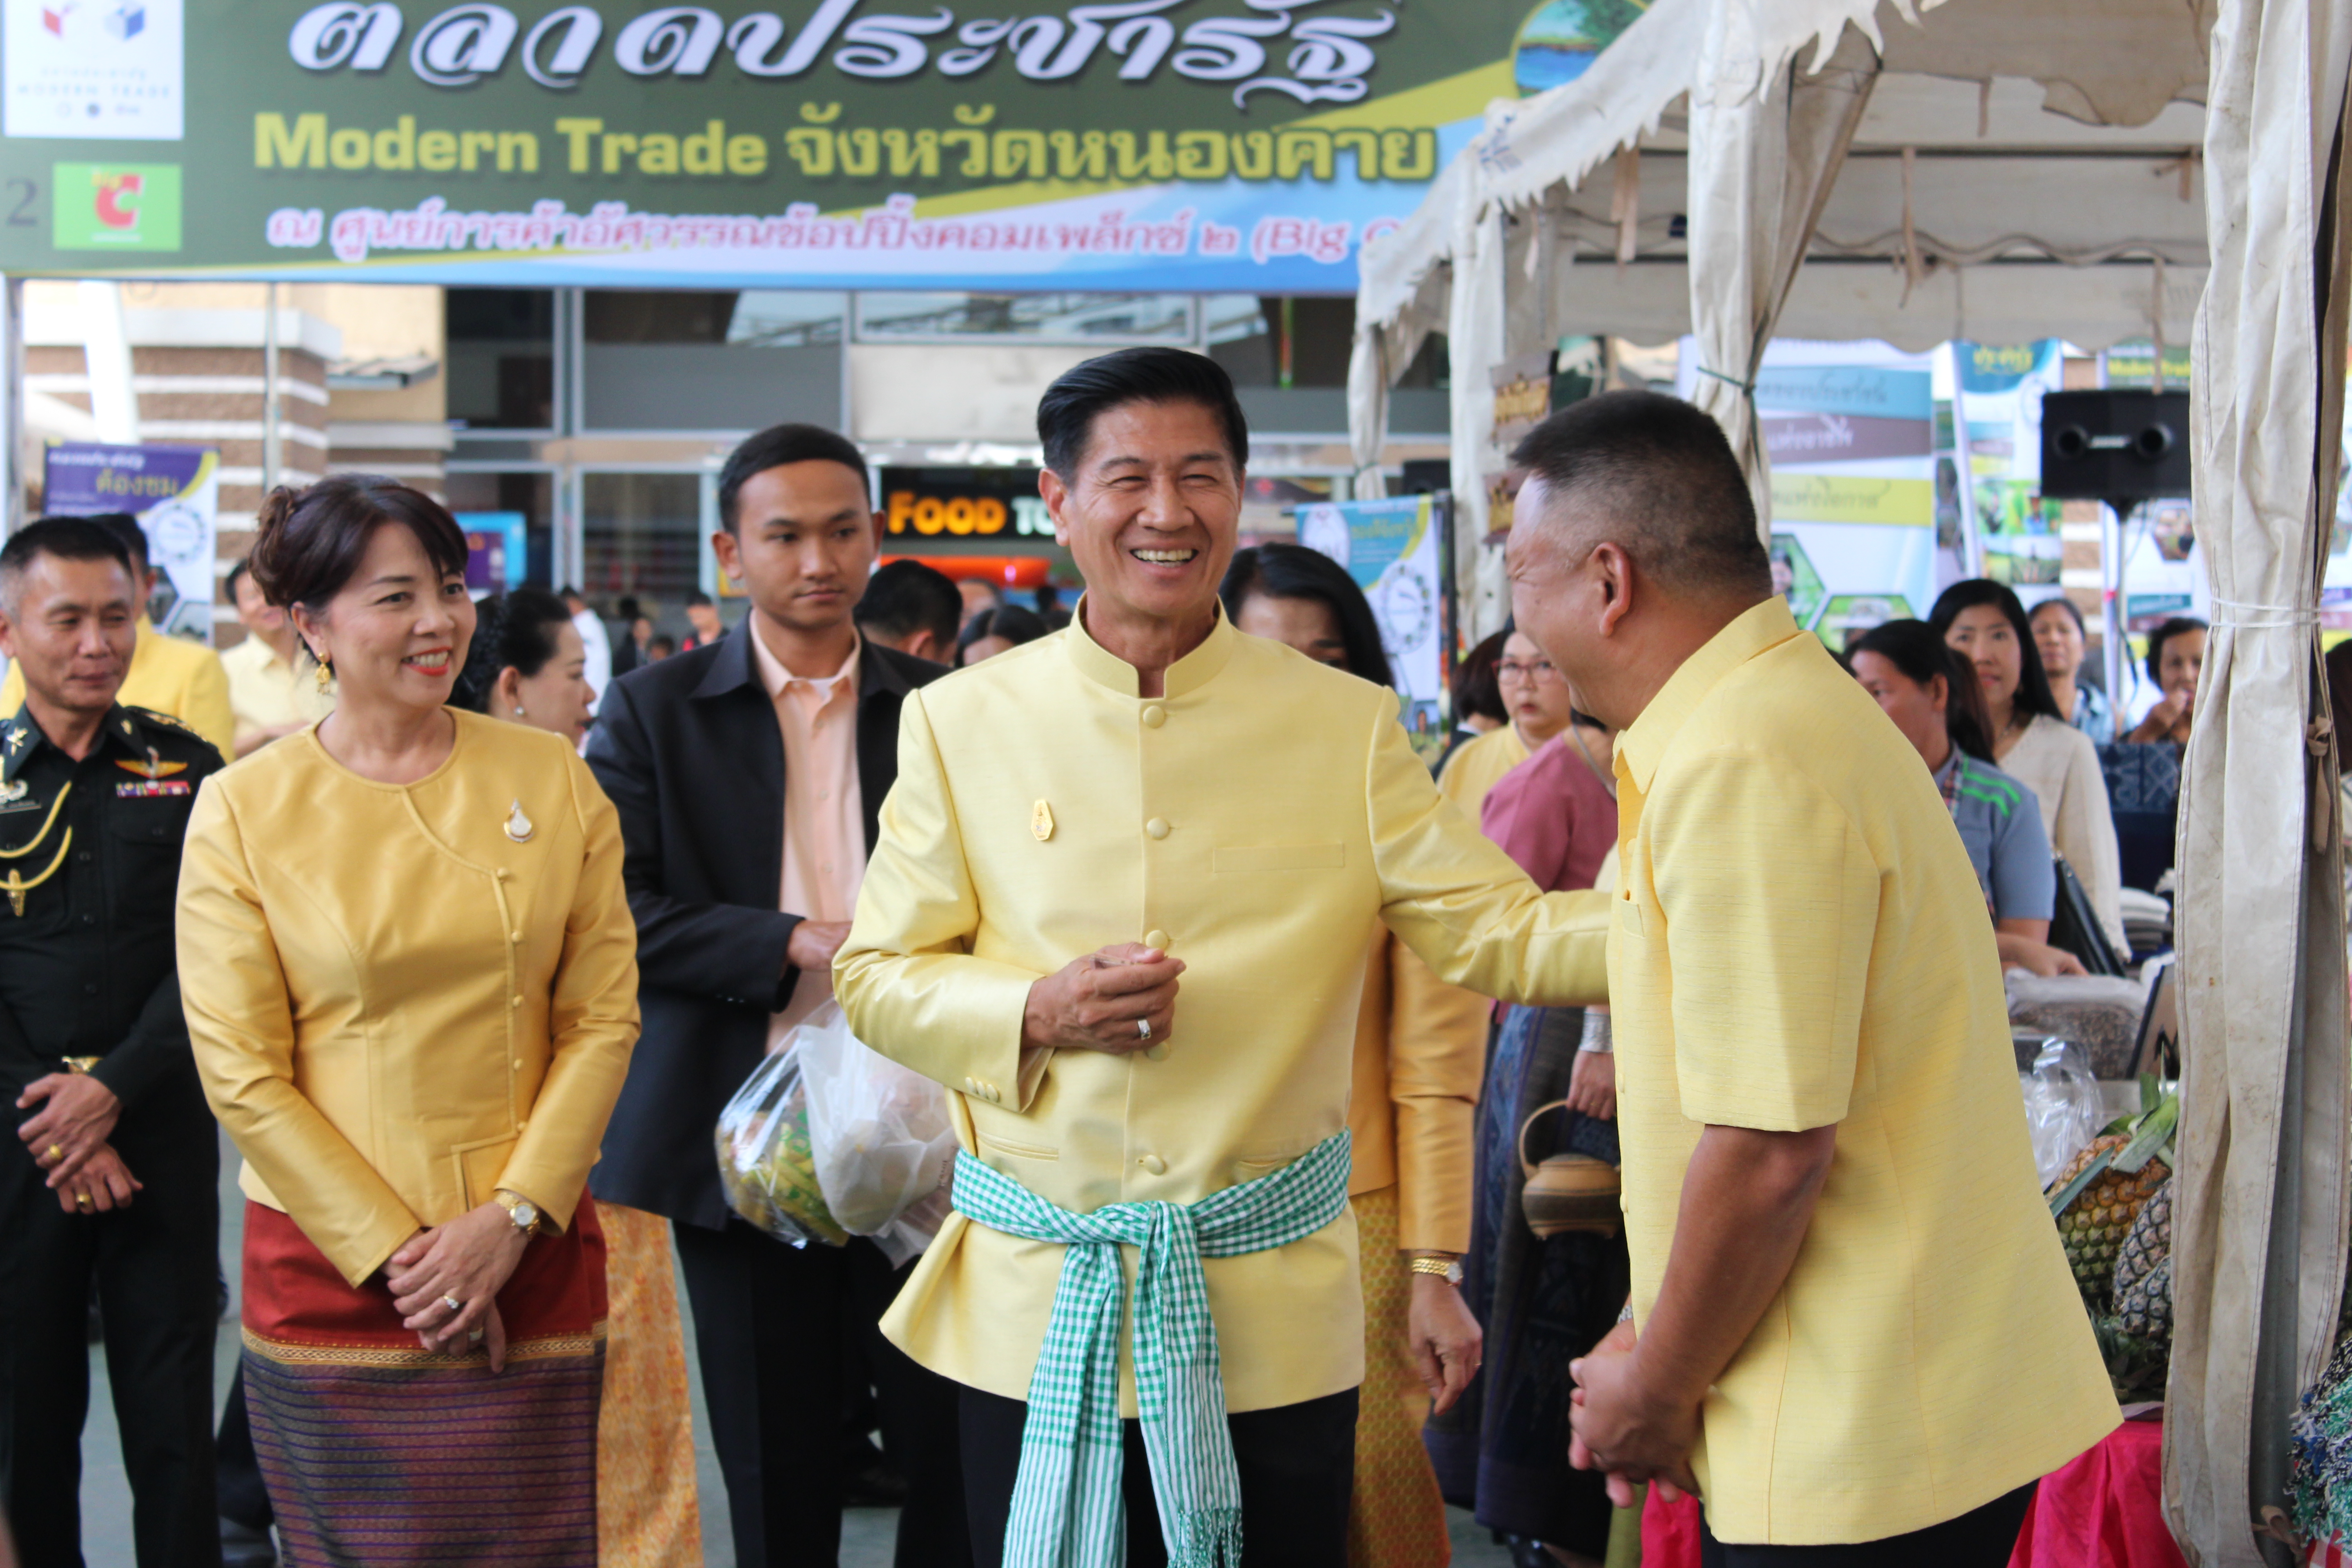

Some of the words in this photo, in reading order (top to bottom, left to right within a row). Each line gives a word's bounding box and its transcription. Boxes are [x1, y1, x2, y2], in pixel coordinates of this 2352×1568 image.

[289, 0, 1400, 109] ตลาดประชารัฐ
[255, 113, 539, 172] Modern
[555, 118, 768, 174] Trade
[785, 103, 1435, 179] จังหวัดหนองคาย
[268, 209, 322, 246] ณ
[1199, 222, 1238, 255] ๒
